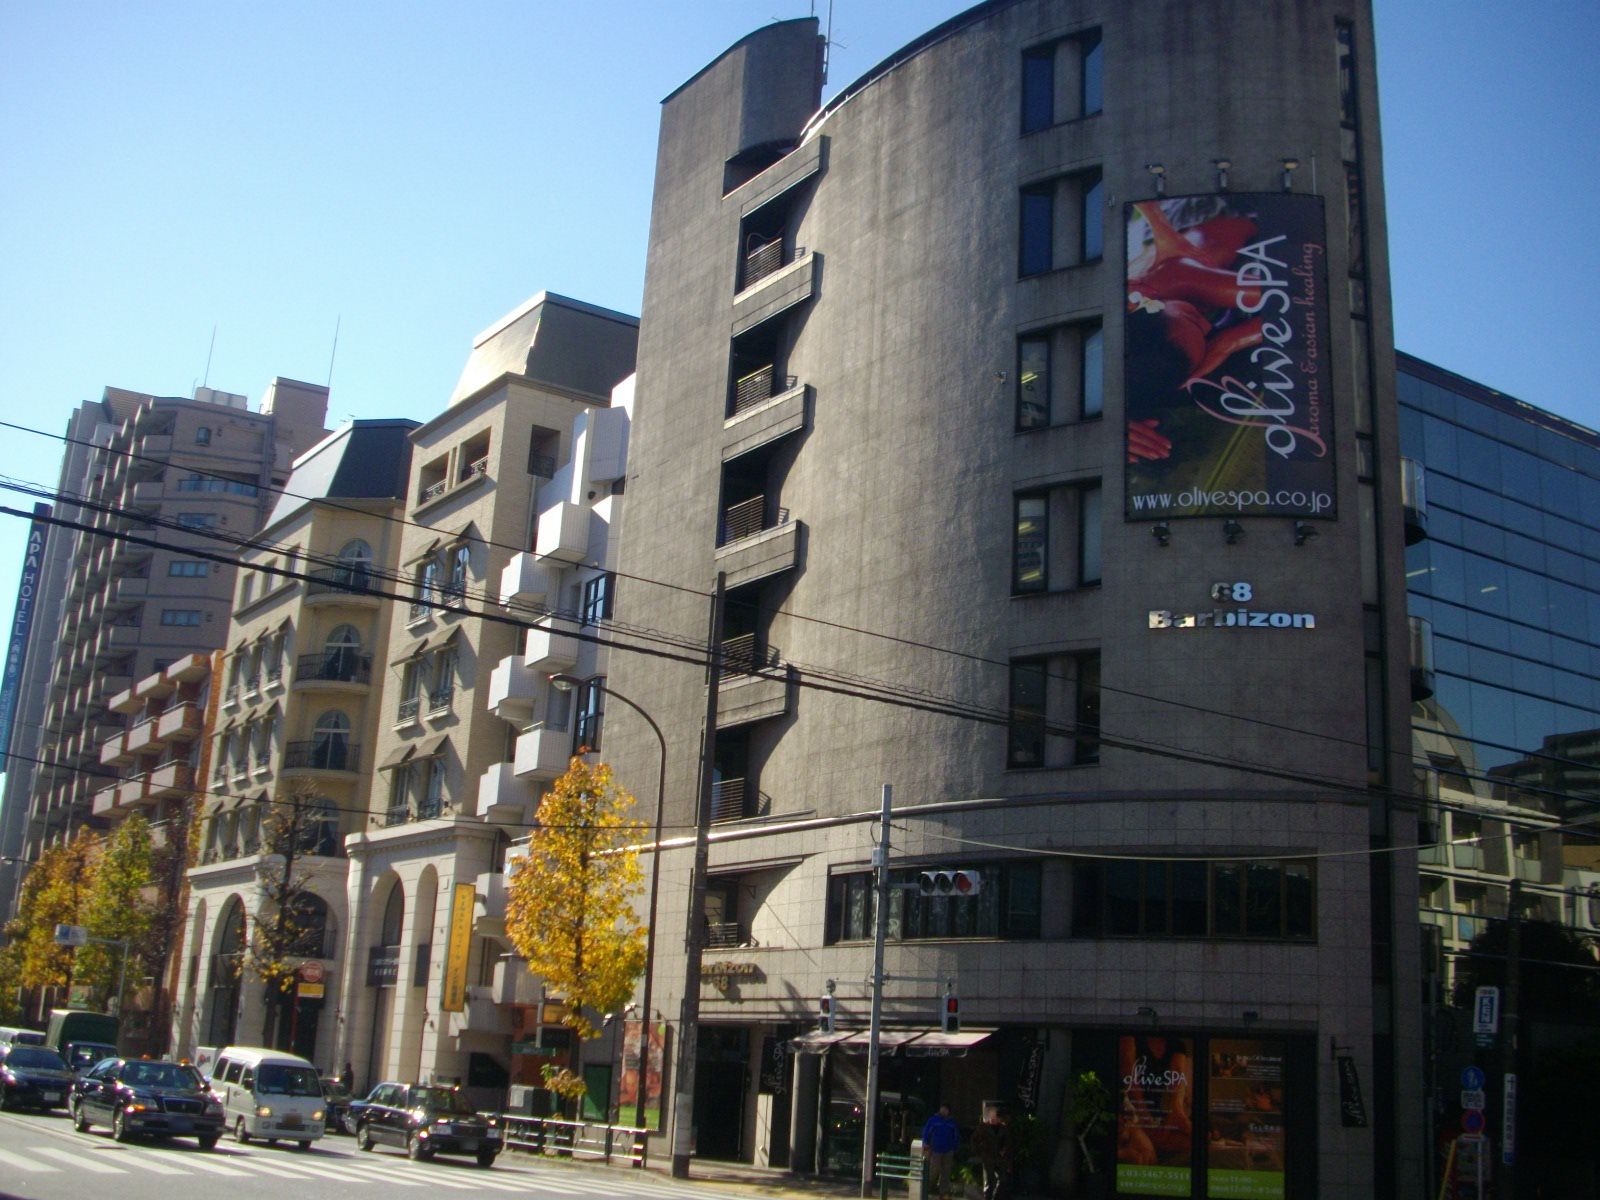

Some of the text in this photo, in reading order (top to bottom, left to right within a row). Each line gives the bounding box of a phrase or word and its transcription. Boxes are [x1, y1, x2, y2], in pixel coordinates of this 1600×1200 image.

[1291, 243, 1325, 437] aroma & asian healing
[1132, 486, 1332, 513] www.olivespa.co.jp
[15, 530, 42, 635] APA HOTEL
[1148, 608, 1316, 629] Barbizon
